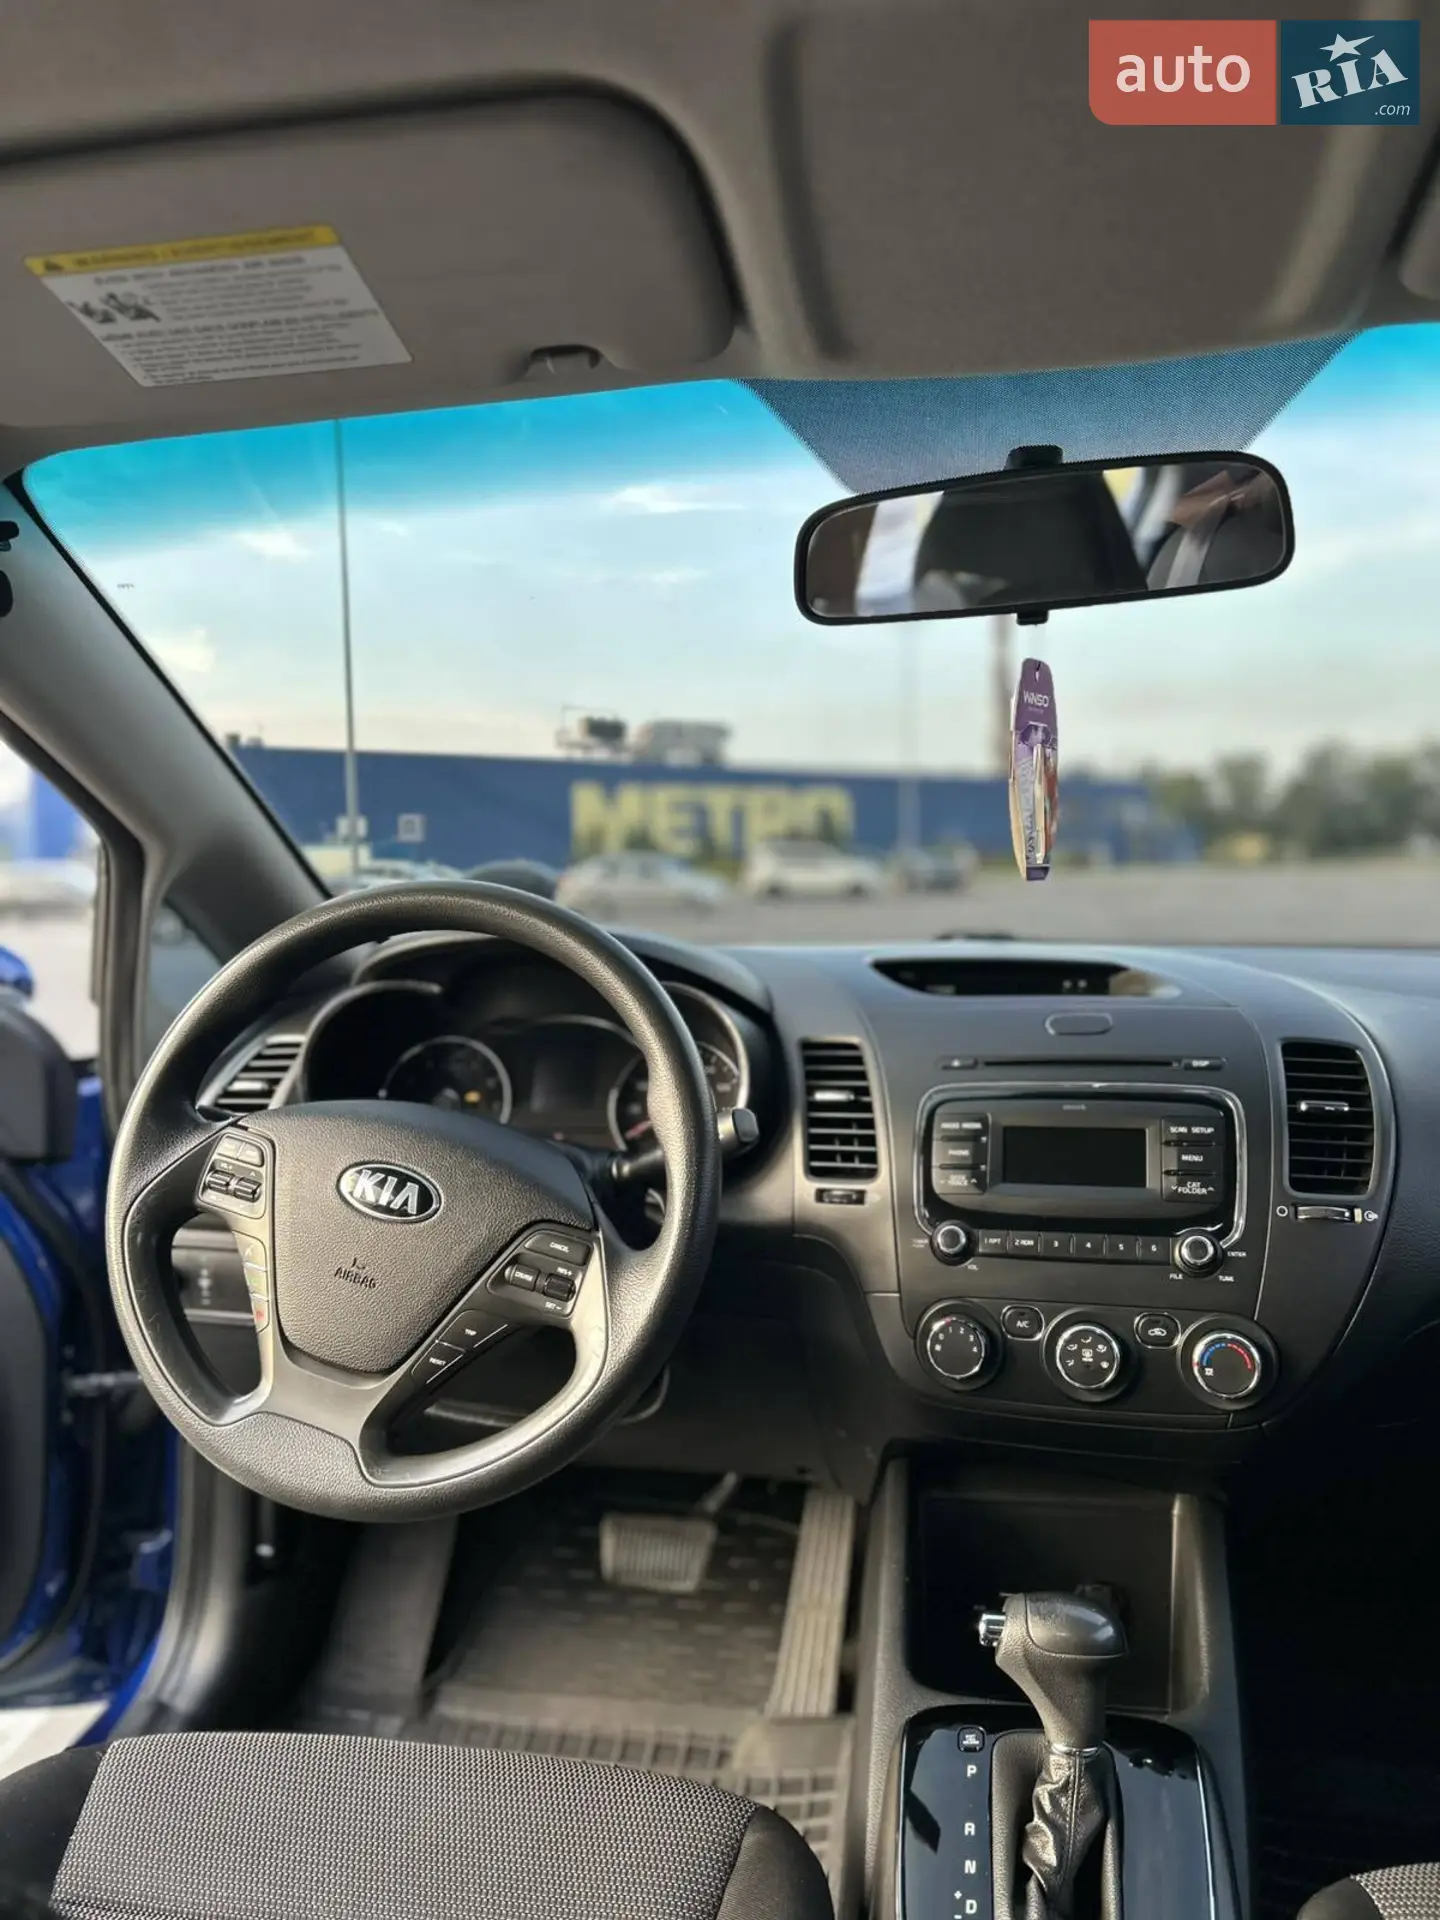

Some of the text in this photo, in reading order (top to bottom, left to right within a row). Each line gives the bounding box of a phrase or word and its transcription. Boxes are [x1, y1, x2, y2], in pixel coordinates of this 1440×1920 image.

[1023, 690, 1050, 708] WINSO
[1191, 1126, 1215, 1134] SETUP
[1181, 1153, 1204, 1162] MENU
[352, 1168, 419, 1215] KIA
[1177, 1186, 1208, 1195] FOLDER
[1085, 1241, 1092, 1249] 4
[333, 1265, 376, 1289] AIRBAG
[1016, 1320, 1031, 1329] A/C
[966, 1764, 977, 1778] P
[964, 1822, 976, 1837] R
[964, 1859, 976, 1875] N
[965, 1899, 978, 1915] D
